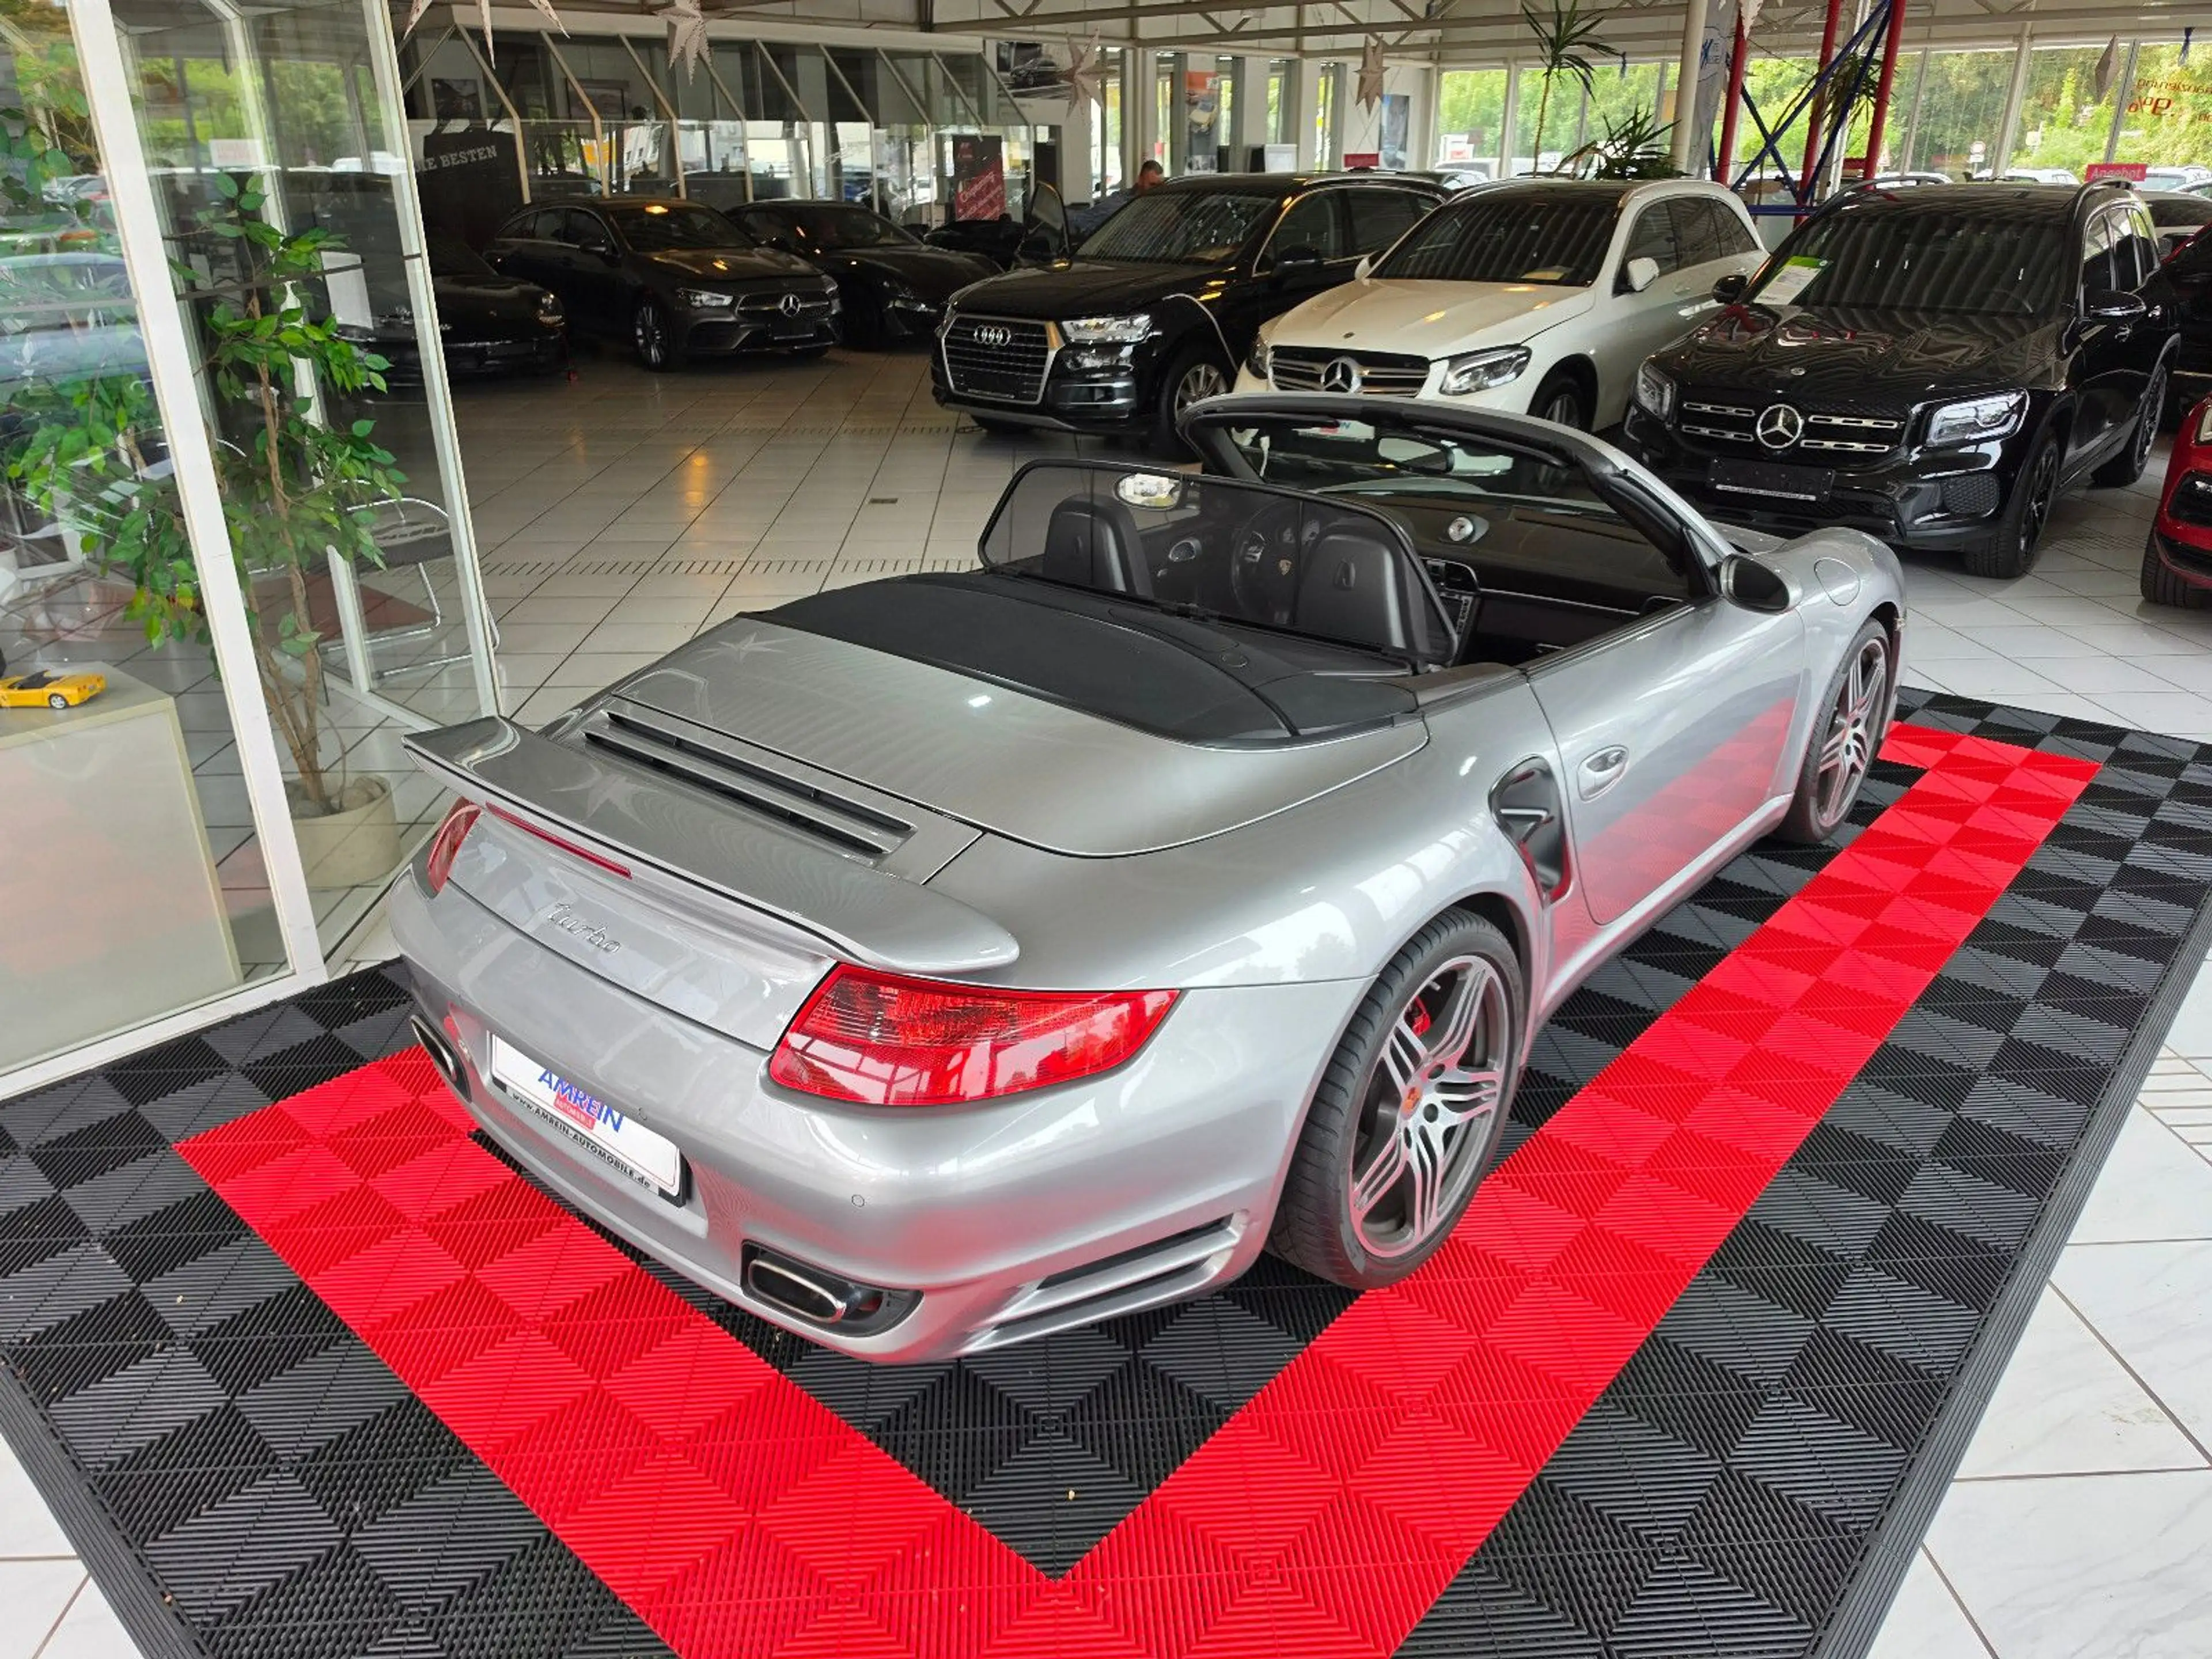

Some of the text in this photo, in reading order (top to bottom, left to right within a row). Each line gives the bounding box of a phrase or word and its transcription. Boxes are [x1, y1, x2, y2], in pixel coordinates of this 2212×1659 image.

[440, 145, 497, 168] BESTEN
[538, 1069, 625, 1133] AMREIN
[513, 1092, 651, 1188] www.AMREIN-AUTOMOBILE.de
